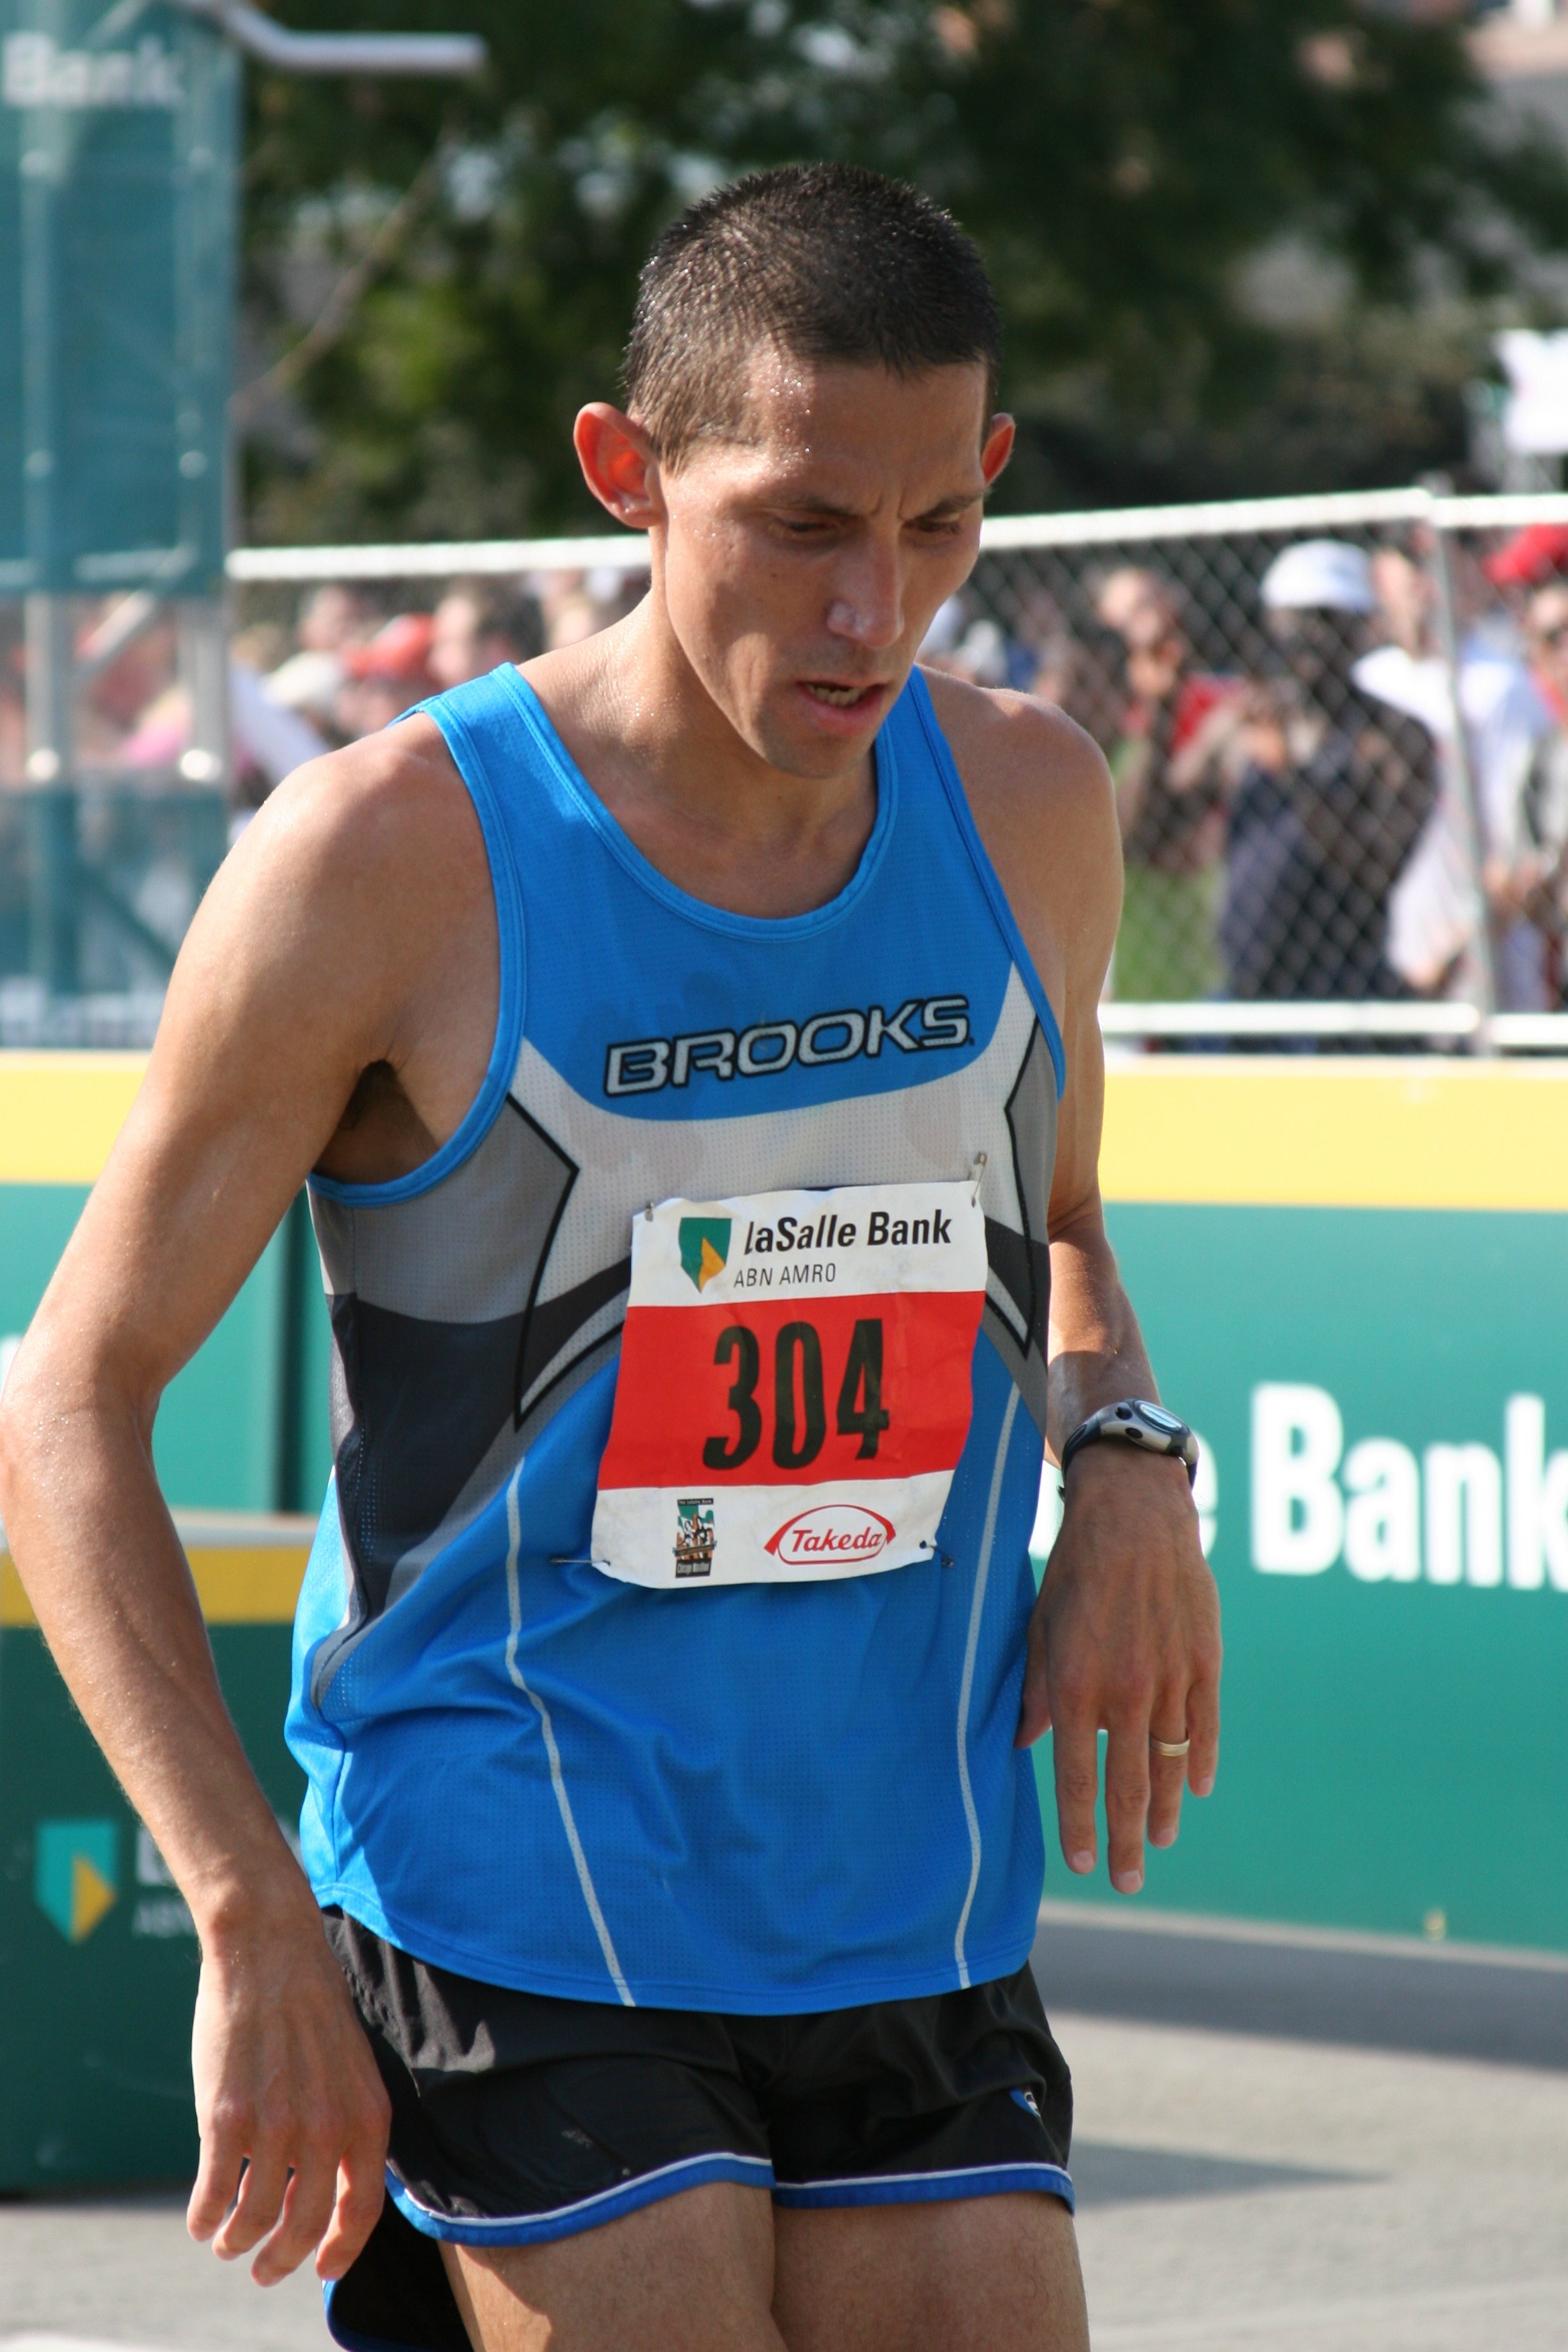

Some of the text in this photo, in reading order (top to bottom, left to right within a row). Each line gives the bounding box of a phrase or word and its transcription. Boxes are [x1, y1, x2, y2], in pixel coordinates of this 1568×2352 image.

[3, 32, 183, 106] Bank
[605, 994, 971, 1098] BROOKS
[867, 1209, 952, 1246] Bank
[734, 1263, 836, 1288] ABN AMRO
[703, 1318, 889, 1470] 304
[1250, 1381, 1568, 1592] Bank
[791, 1526, 883, 1553] Takeda
